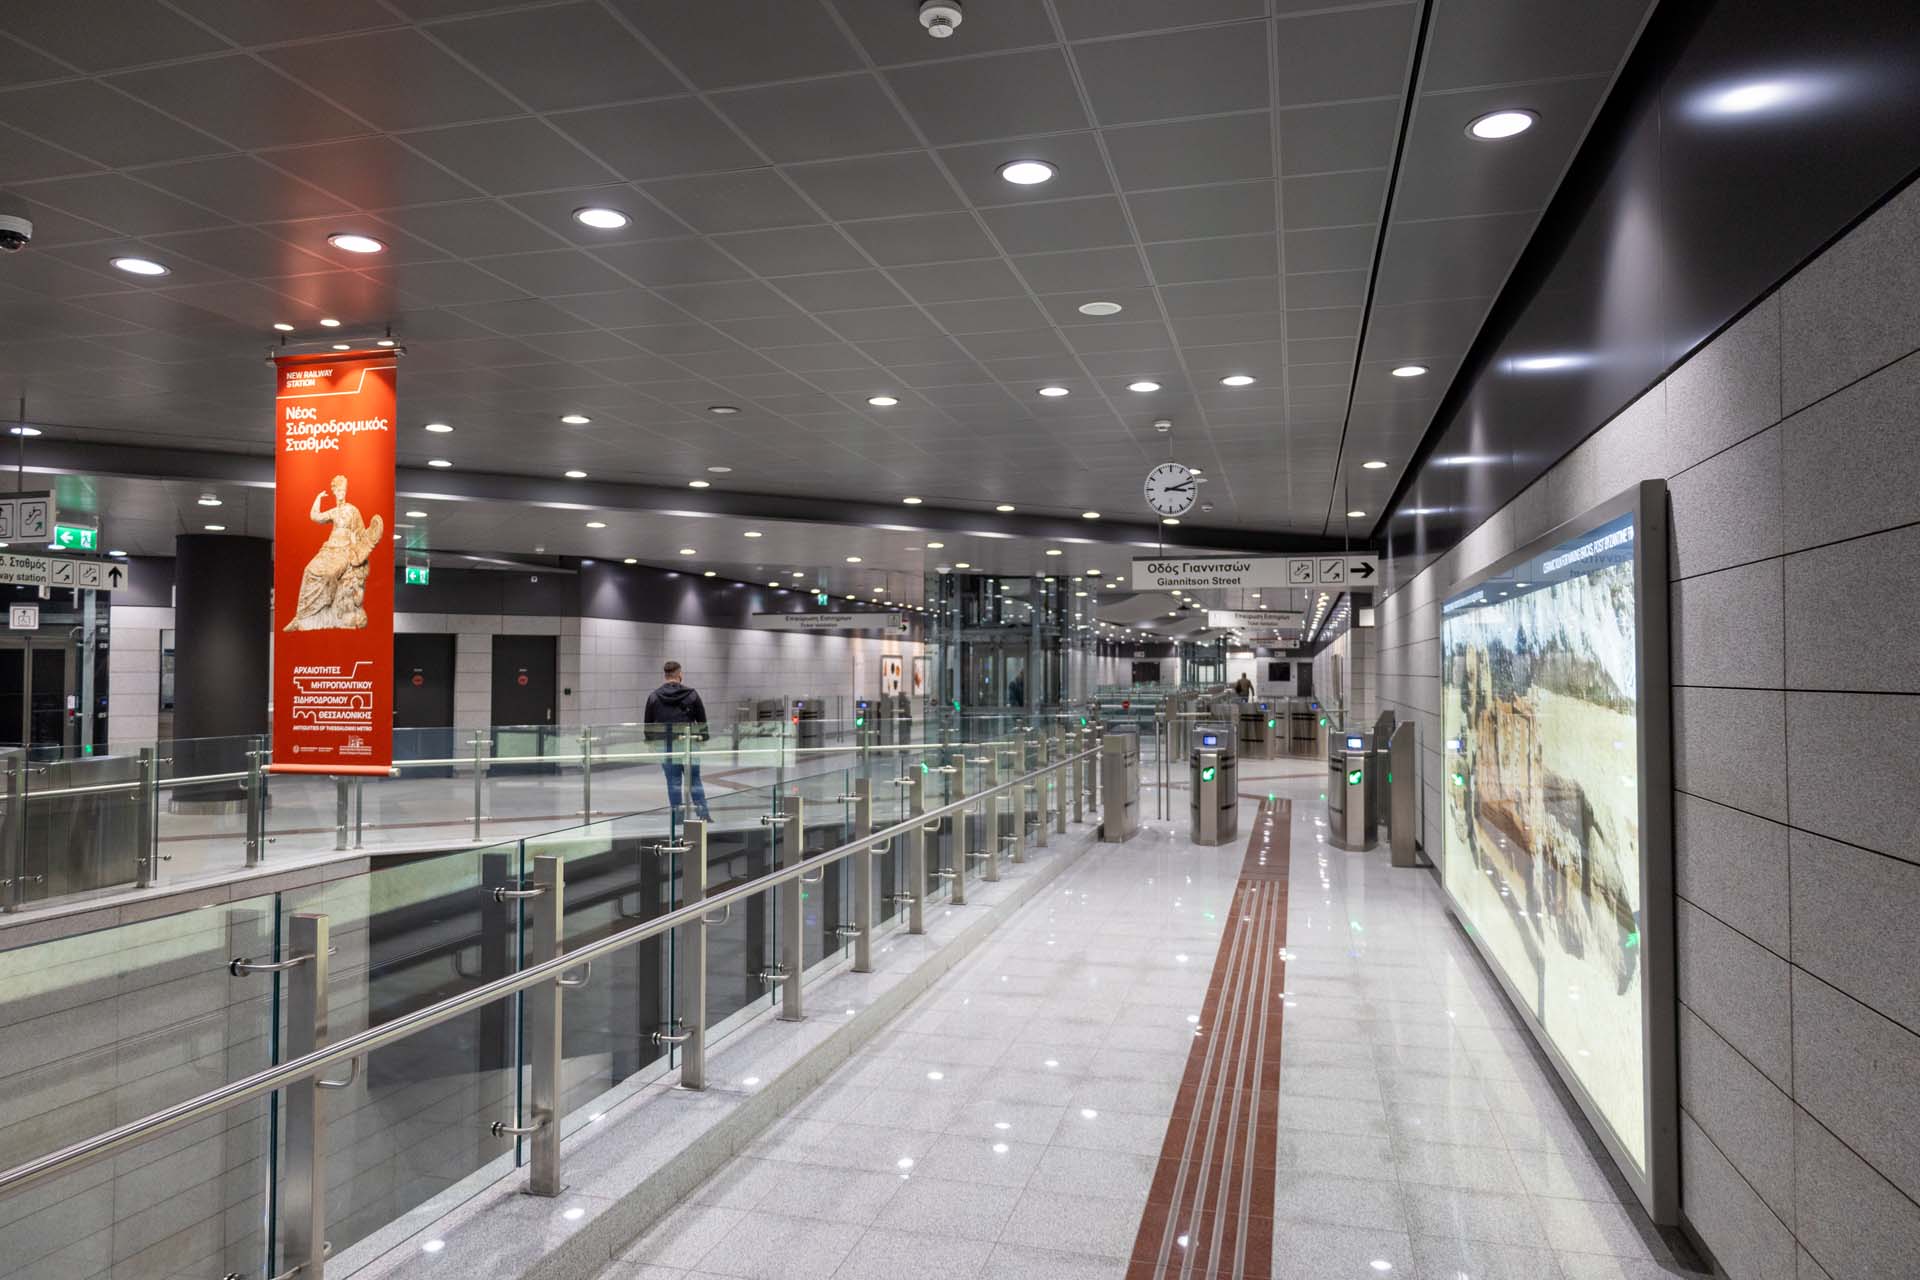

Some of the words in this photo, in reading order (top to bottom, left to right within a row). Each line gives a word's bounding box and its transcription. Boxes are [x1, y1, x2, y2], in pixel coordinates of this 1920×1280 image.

[286, 371, 303, 380] NEW
[303, 369, 334, 378] RAILWAY
[286, 379, 316, 388] STATION
[286, 406, 316, 419] Νέος
[286, 417, 388, 436] Σιδηροδρομικός
[286, 436, 339, 452] Σταθμός
[10, 556, 46, 572] Σταθμός
[1147, 562, 1179, 575] Οδός
[1182, 561, 1251, 573] Γιαννιτσών
[16, 573, 47, 582] station
[1157, 577, 1209, 586] Giannitson
[1212, 576, 1241, 585] Street
[293, 666, 341, 674] ΑΡΧΑΙΟΤΗΤΕΣ
[311, 681, 373, 689] ΜΗΤΡΟΠΟΛΙΤΙΚΟΥ
[293, 696, 348, 704] ΣΙΔΗΡΟΔΡΟΜΟΥ
[318, 711, 372, 719] ΘΕΣΣΑΛΟΝΙΚΗΣ
